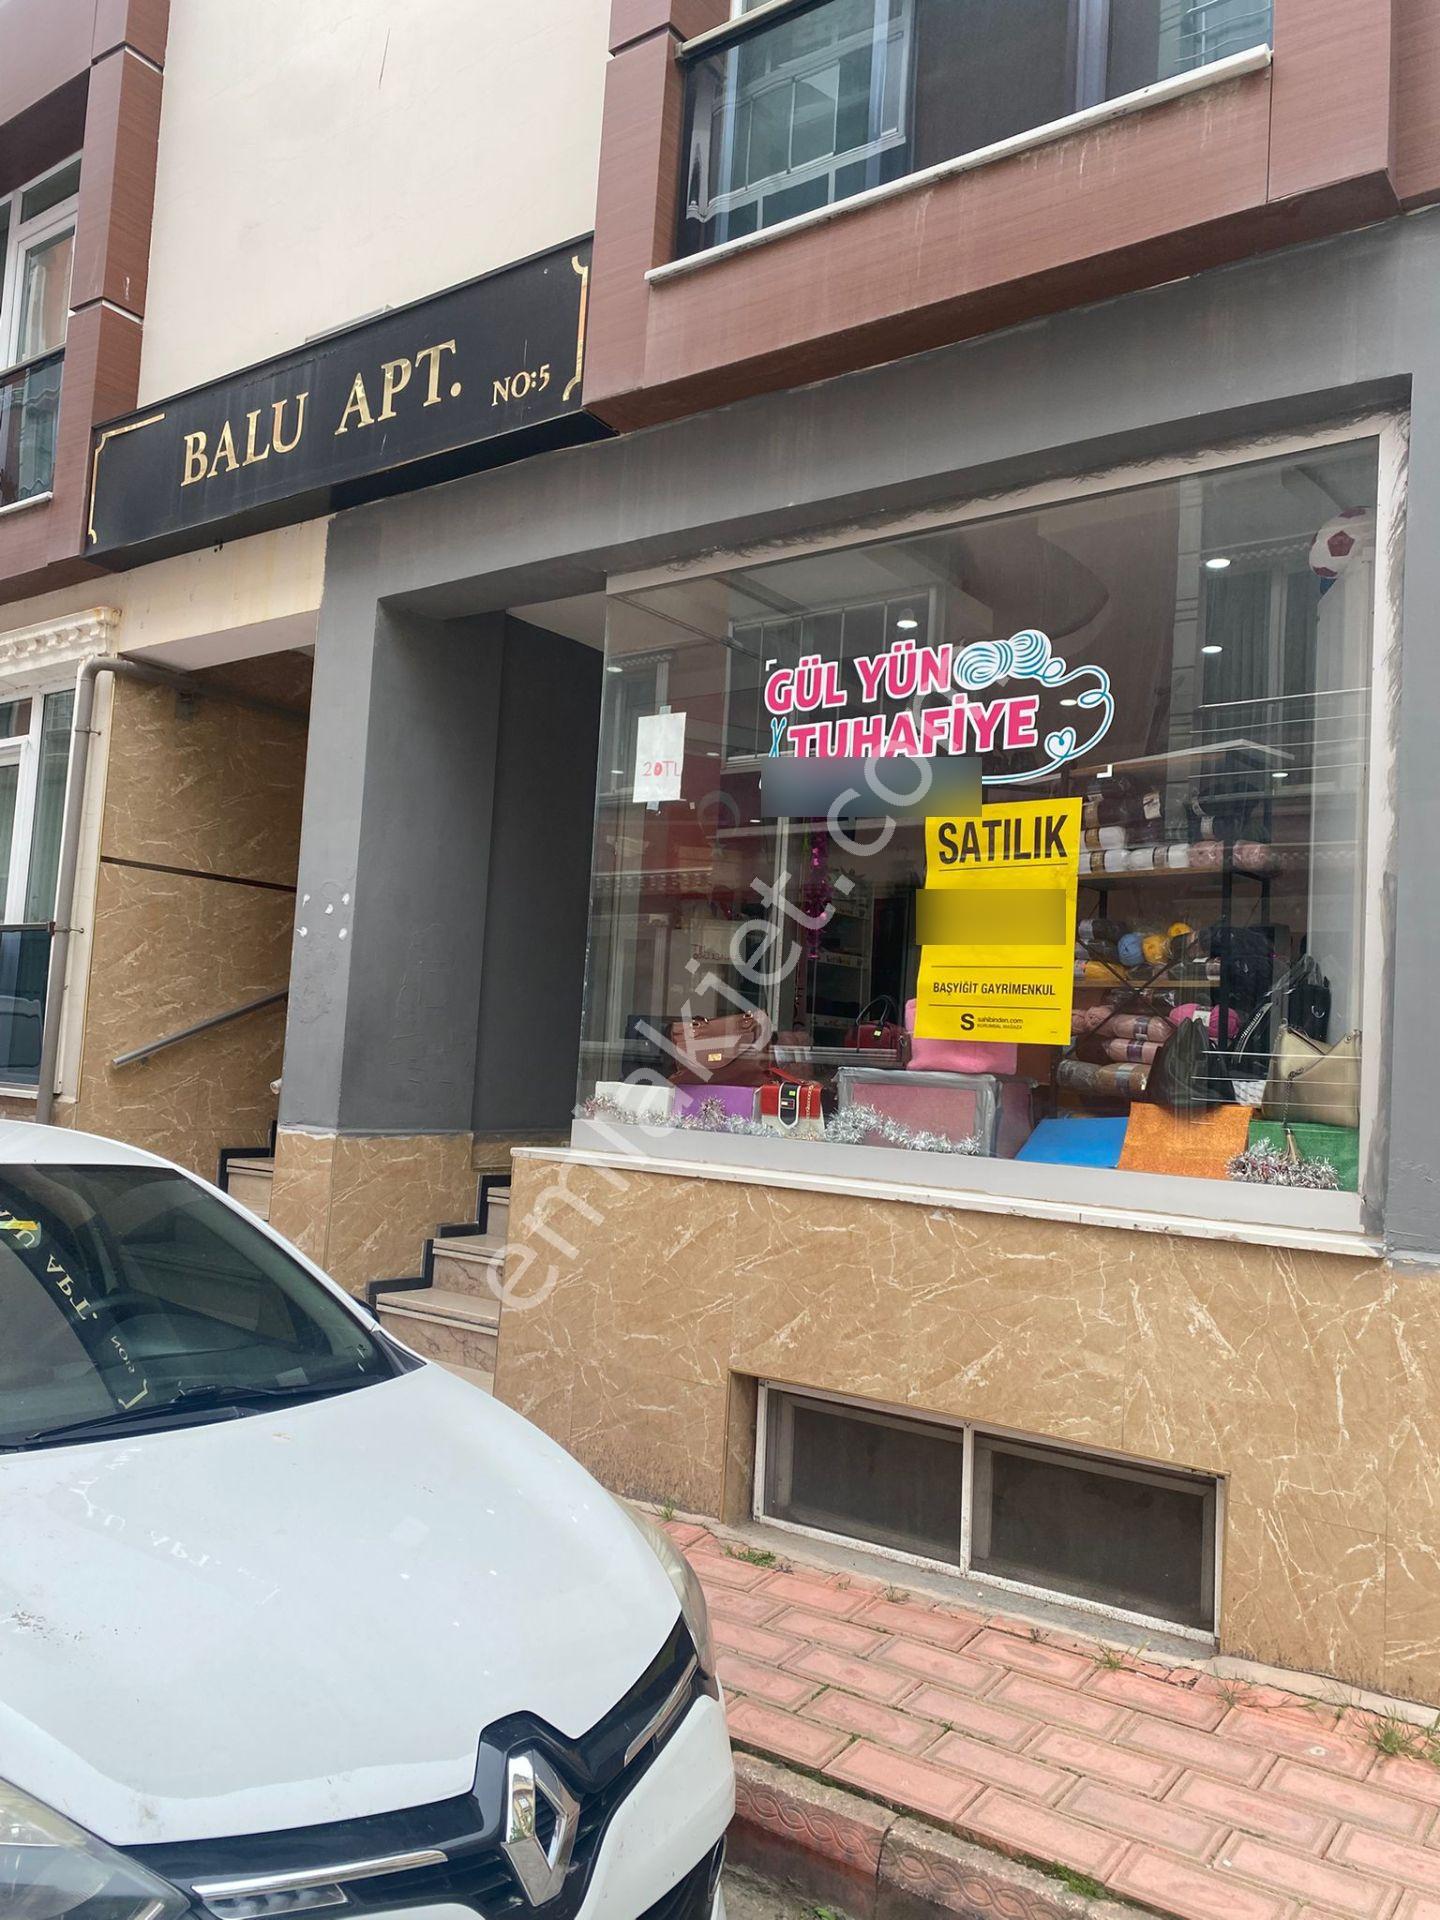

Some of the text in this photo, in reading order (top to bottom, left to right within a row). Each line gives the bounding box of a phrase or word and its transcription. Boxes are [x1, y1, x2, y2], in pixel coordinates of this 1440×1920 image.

[180, 339, 551, 487] BALU APT. NO:5
[765, 639, 953, 714] GÜL YÜN
[787, 692, 1039, 758] TUHAFİYE
[938, 814, 1068, 865] SATILIK
[933, 981, 1056, 996] BAŞYİĞİT GAYRİMENKUL
